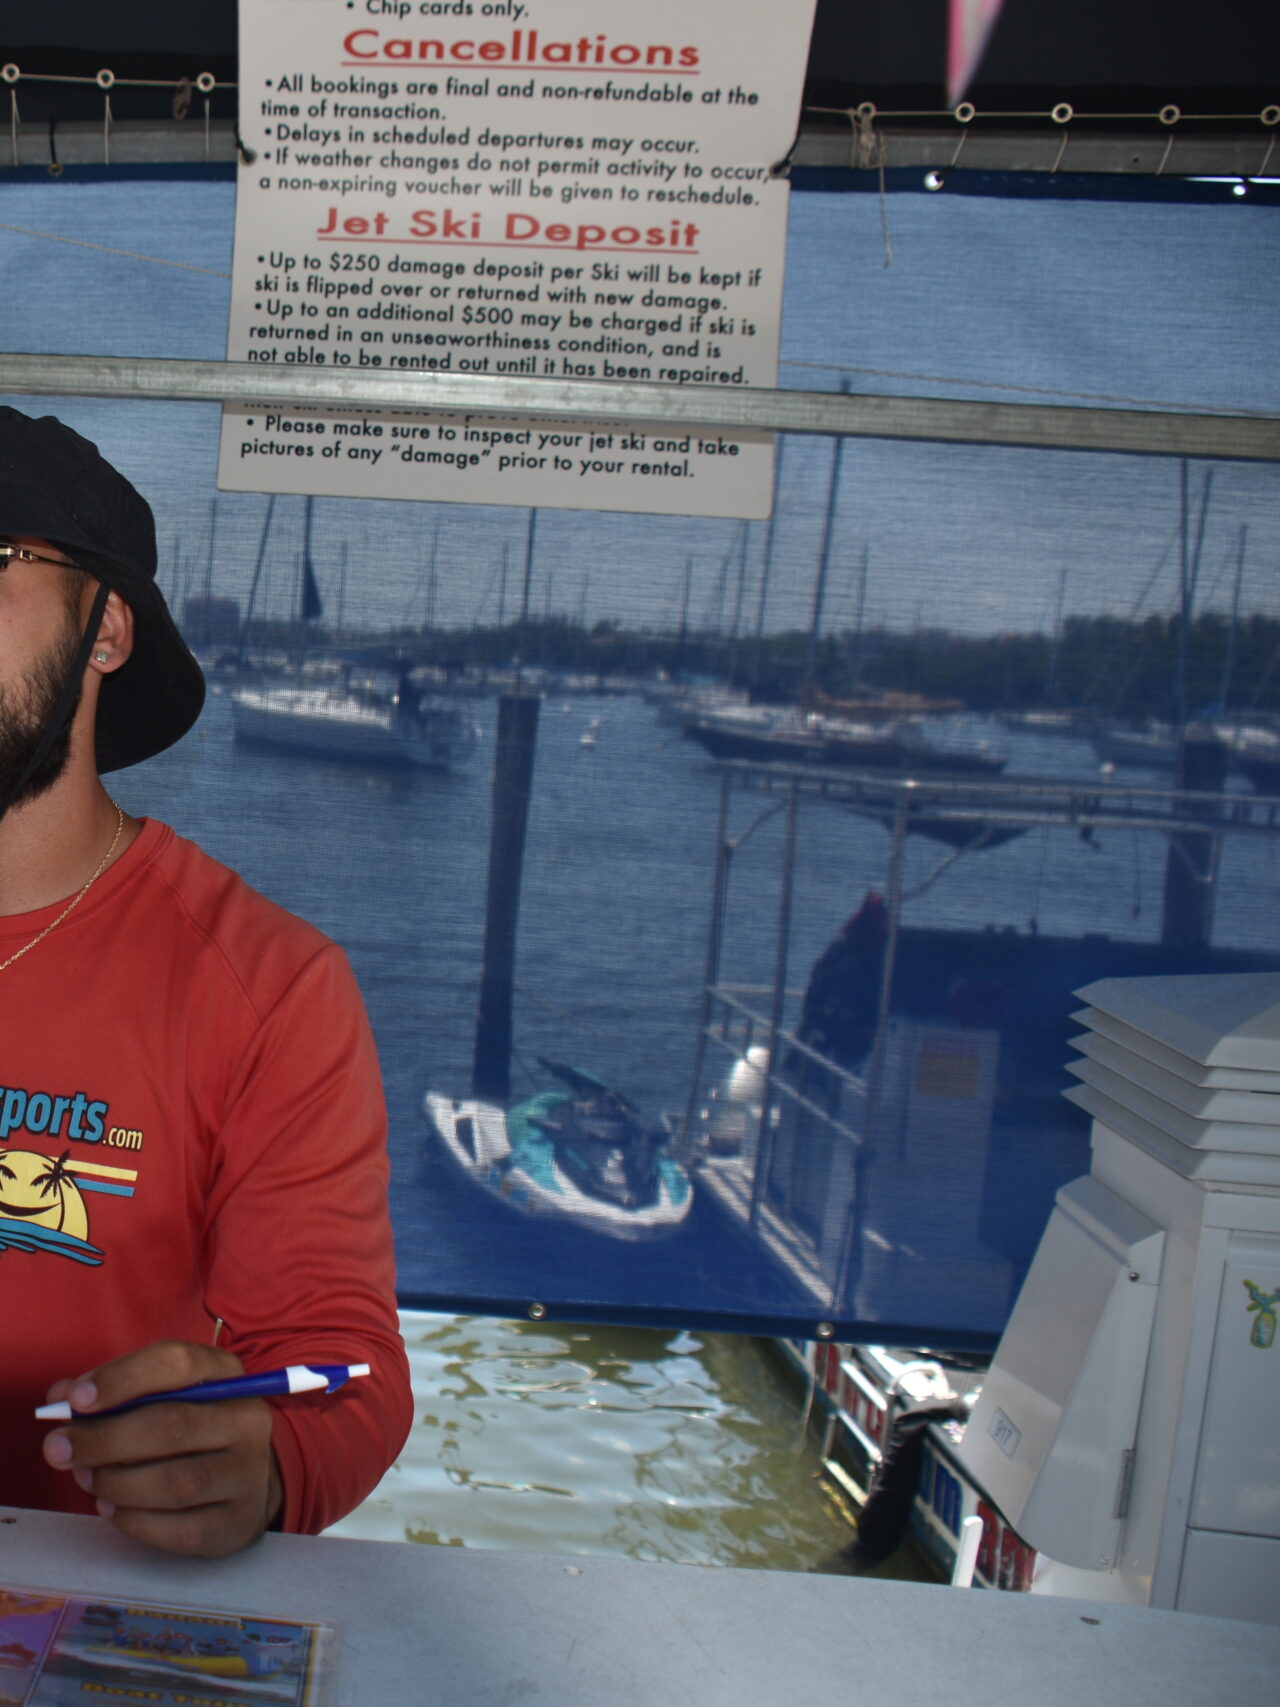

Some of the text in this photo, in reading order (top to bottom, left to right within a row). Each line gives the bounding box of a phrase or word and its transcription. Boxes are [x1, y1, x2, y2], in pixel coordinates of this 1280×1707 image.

[366, 0, 529, 22] Chip cards only.
[343, 28, 700, 68] Cancellations
[260, 98, 446, 120] time of transaction.
[276, 74, 759, 106] All bookings are final and non-refundable at the
[276, 123, 699, 156] Delays in scheduled departures may occur.
[276, 146, 288, 165] If
[295, 148, 372, 167] weather
[379, 150, 460, 174] changes
[466, 152, 492, 171] do
[499, 157, 530, 172] not
[537, 158, 600, 177] permit
[606, 161, 677, 182] activity
[684, 162, 703, 178] to
[258, 176, 759, 206] a non-expiring voucher will be given to reschedule.
[317, 207, 699, 250] Jet Ski Deposit
[269, 251, 762, 291] Up to $250 damage deposit per Ski will be kept if
[254, 273, 728, 315] ski is flipped over or returned with new damage.
[266, 298, 756, 337] Up to an additional $500 may be charged if ski is
[249, 323, 722, 359] returned in an unseaworthiness condition, and is
[247, 345, 749, 384] not able to be rented out until it has been repaired.
[265, 414, 740, 456] Please make sure to inspect your jet ski and take
[240, 438, 315, 459] pictures
[321, 440, 342, 458] of
[346, 447, 384, 466] any
[498, 451, 548, 472] prior
[553, 455, 573, 471] to
[580, 460, 625, 477] your
[631, 459, 694, 478] rental.
